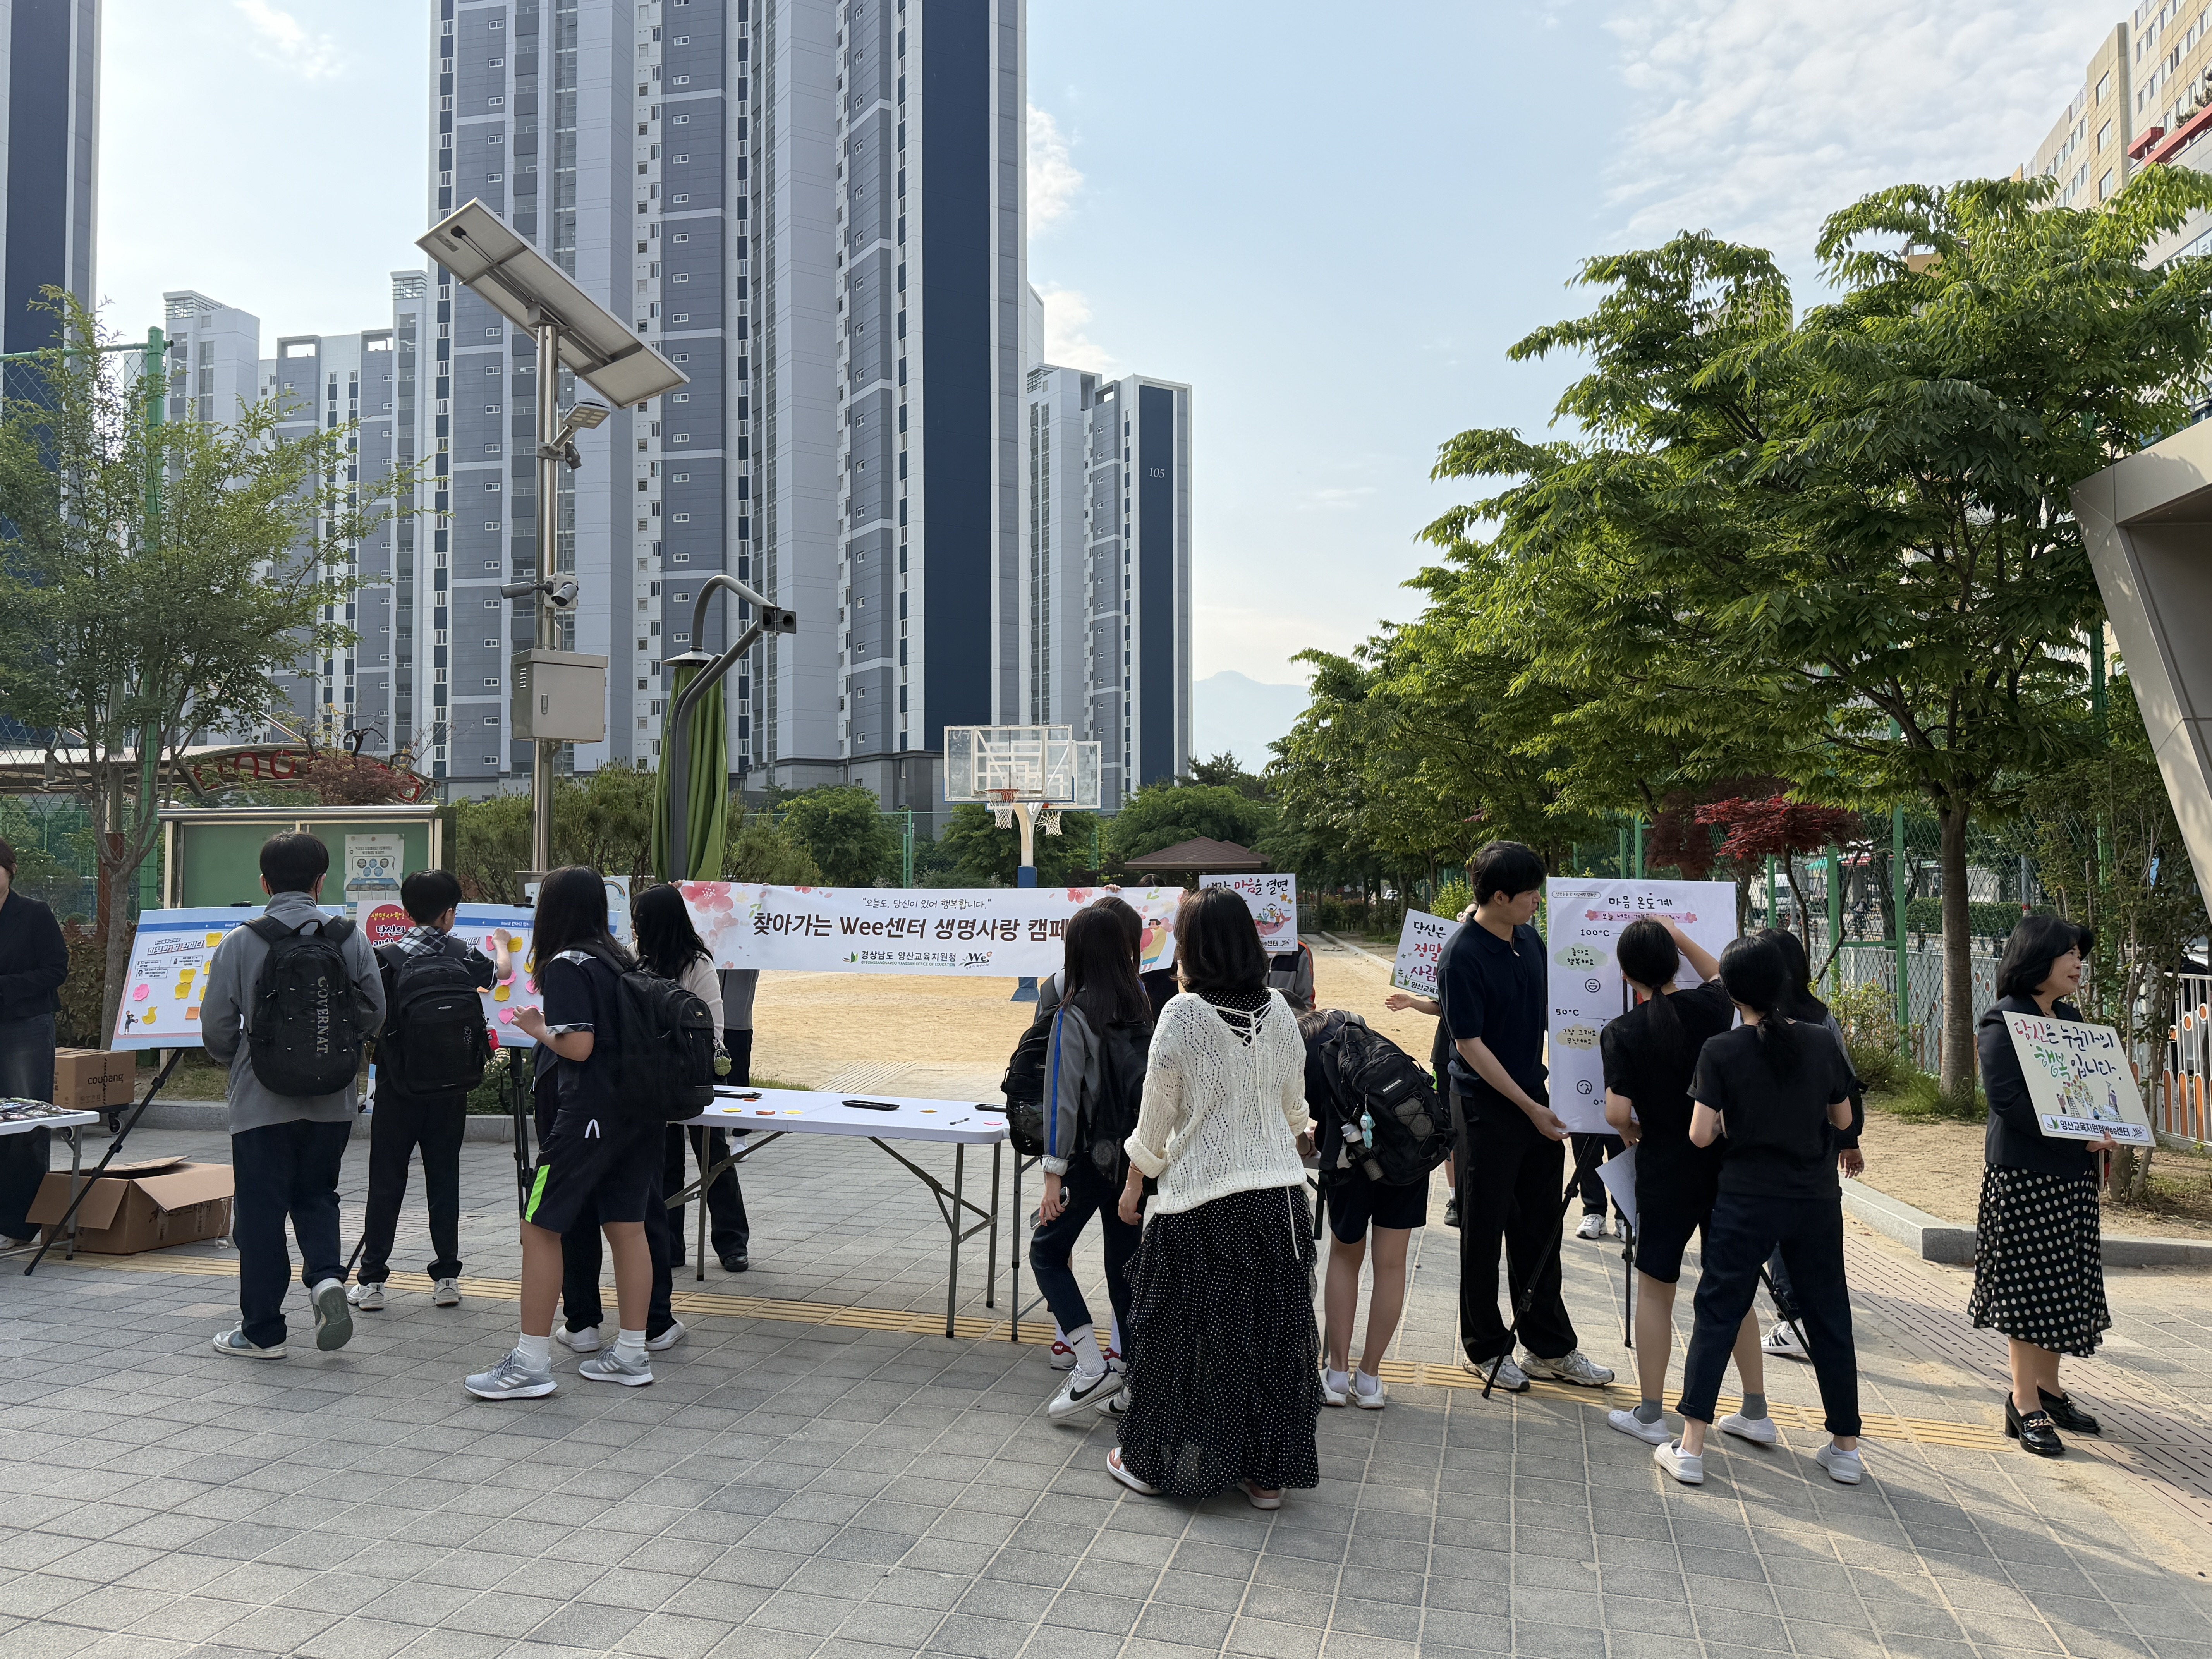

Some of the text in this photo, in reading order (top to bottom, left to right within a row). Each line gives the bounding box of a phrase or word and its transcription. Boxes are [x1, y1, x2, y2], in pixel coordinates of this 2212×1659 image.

[1149, 467, 1165, 478] 105
[1234, 878, 1262, 895] 마음을
[1266, 879, 1288, 895] 열면
[863, 897, 991, 910] "오늘도, 당신이 있어 행복합니다."
[1609, 896, 1672, 909] 마음 온도계
[371, 912, 404, 921] 생명사랑!
[376, 924, 406, 937] 당신의
[753, 912, 1069, 942] 찾아가는 Wee센터 생명사랑 캠페
[1413, 921, 1446, 939] 당신은
[861, 951, 956, 962] 경상남도 양산교육지원청
[1414, 943, 1442, 962] 정말
[2014, 1019, 2114, 1051] 당신은 누군가의
[88, 1073, 124, 1084] coupang
